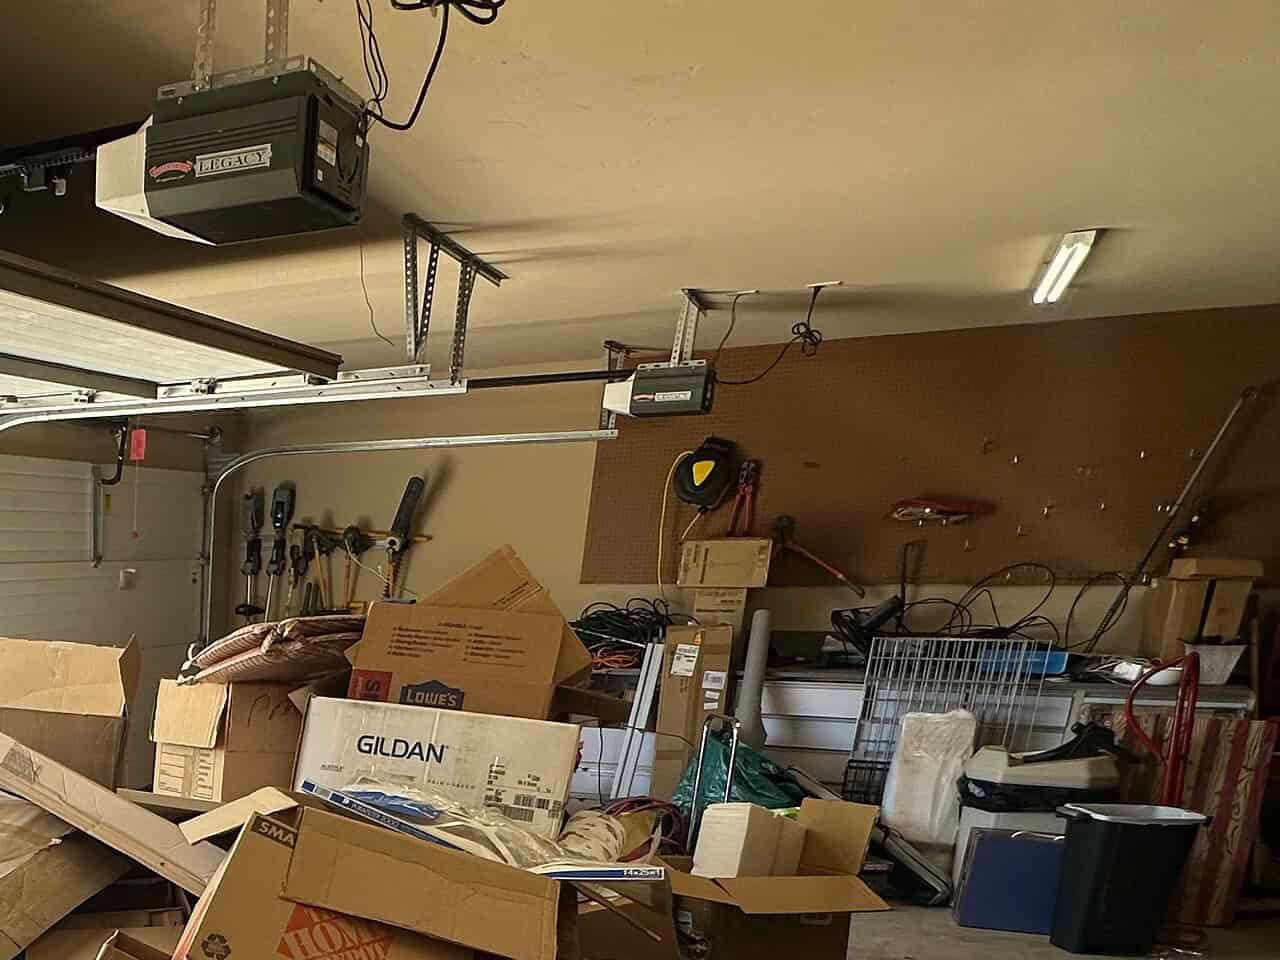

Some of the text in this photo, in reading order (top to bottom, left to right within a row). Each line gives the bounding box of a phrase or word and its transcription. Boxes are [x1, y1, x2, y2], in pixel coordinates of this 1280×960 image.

[198, 151, 267, 174] LEGACY
[405, 689, 457, 707] LOWE'S
[357, 735, 445, 763] GILDAN
[258, 822, 296, 846] SMA
